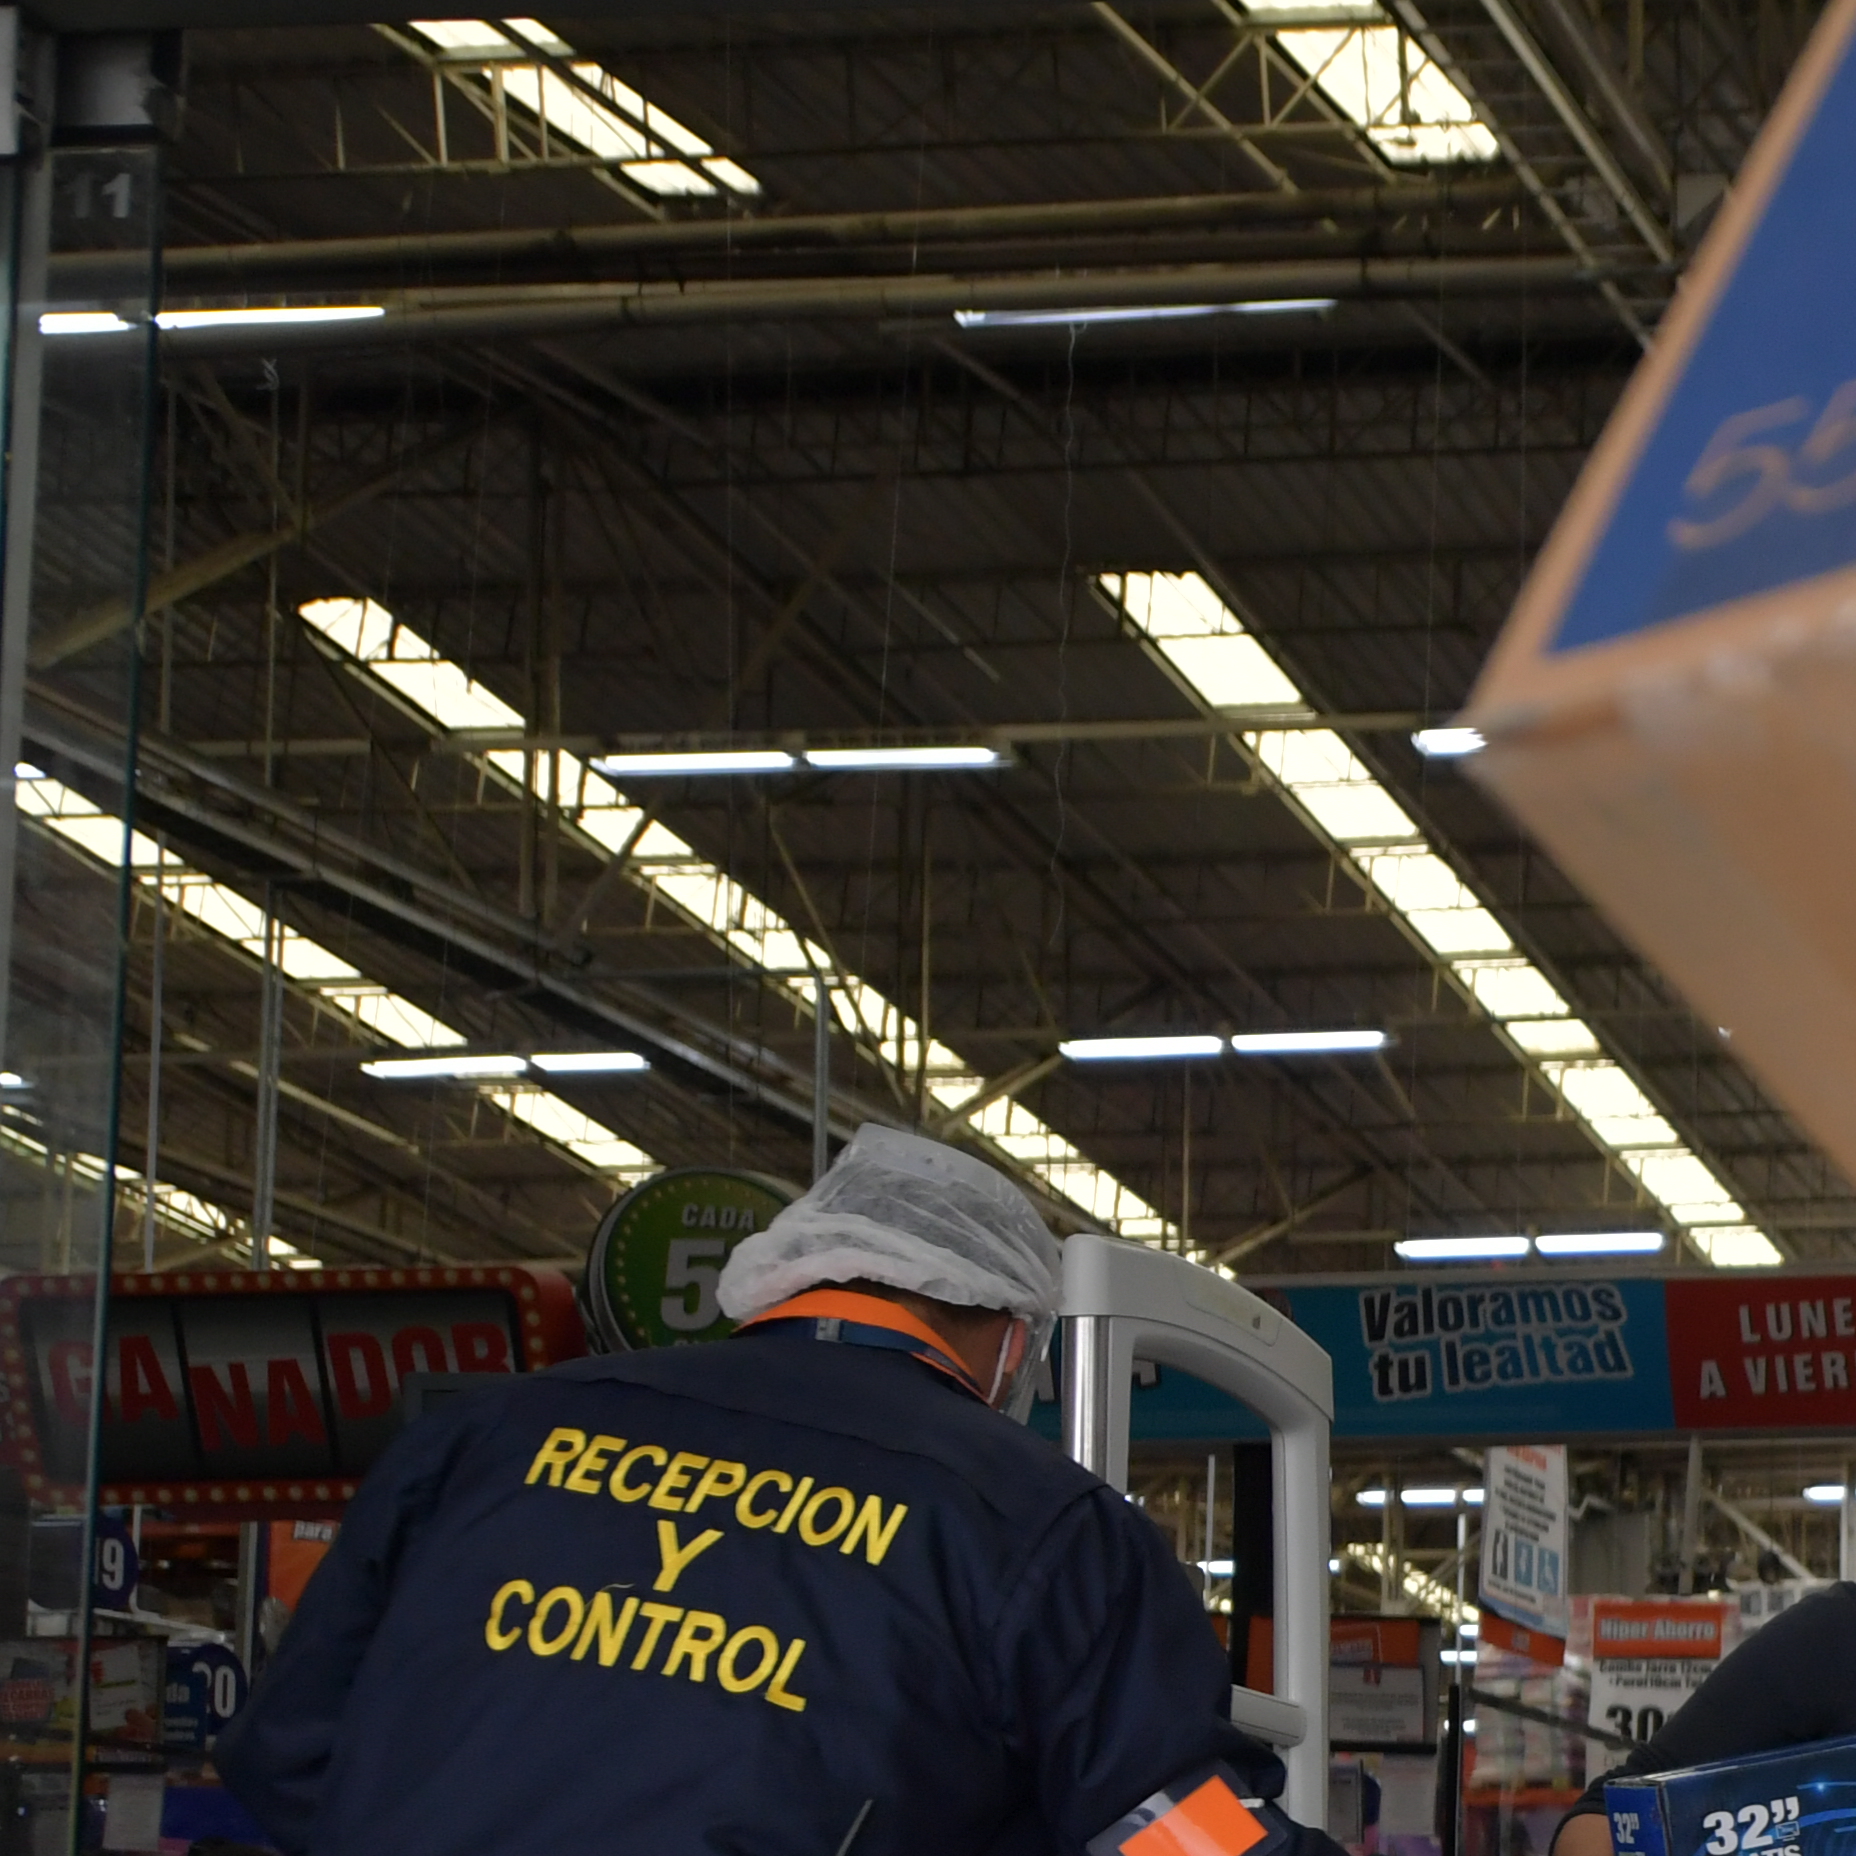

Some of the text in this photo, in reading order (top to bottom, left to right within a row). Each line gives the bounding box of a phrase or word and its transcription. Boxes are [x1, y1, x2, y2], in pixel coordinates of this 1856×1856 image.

[681, 1204, 756, 1230] CADA
[1361, 1284, 1625, 1345] Valoramos
[1372, 1330, 1633, 1400] tu lealtad
[1700, 1359, 1728, 1399] A
[524, 1427, 908, 1566] RECEPCION
[656, 1520, 725, 1593] Y
[485, 1580, 807, 1713] CONTROL
[1600, 1618, 1716, 1640] Hiper Ahorro
